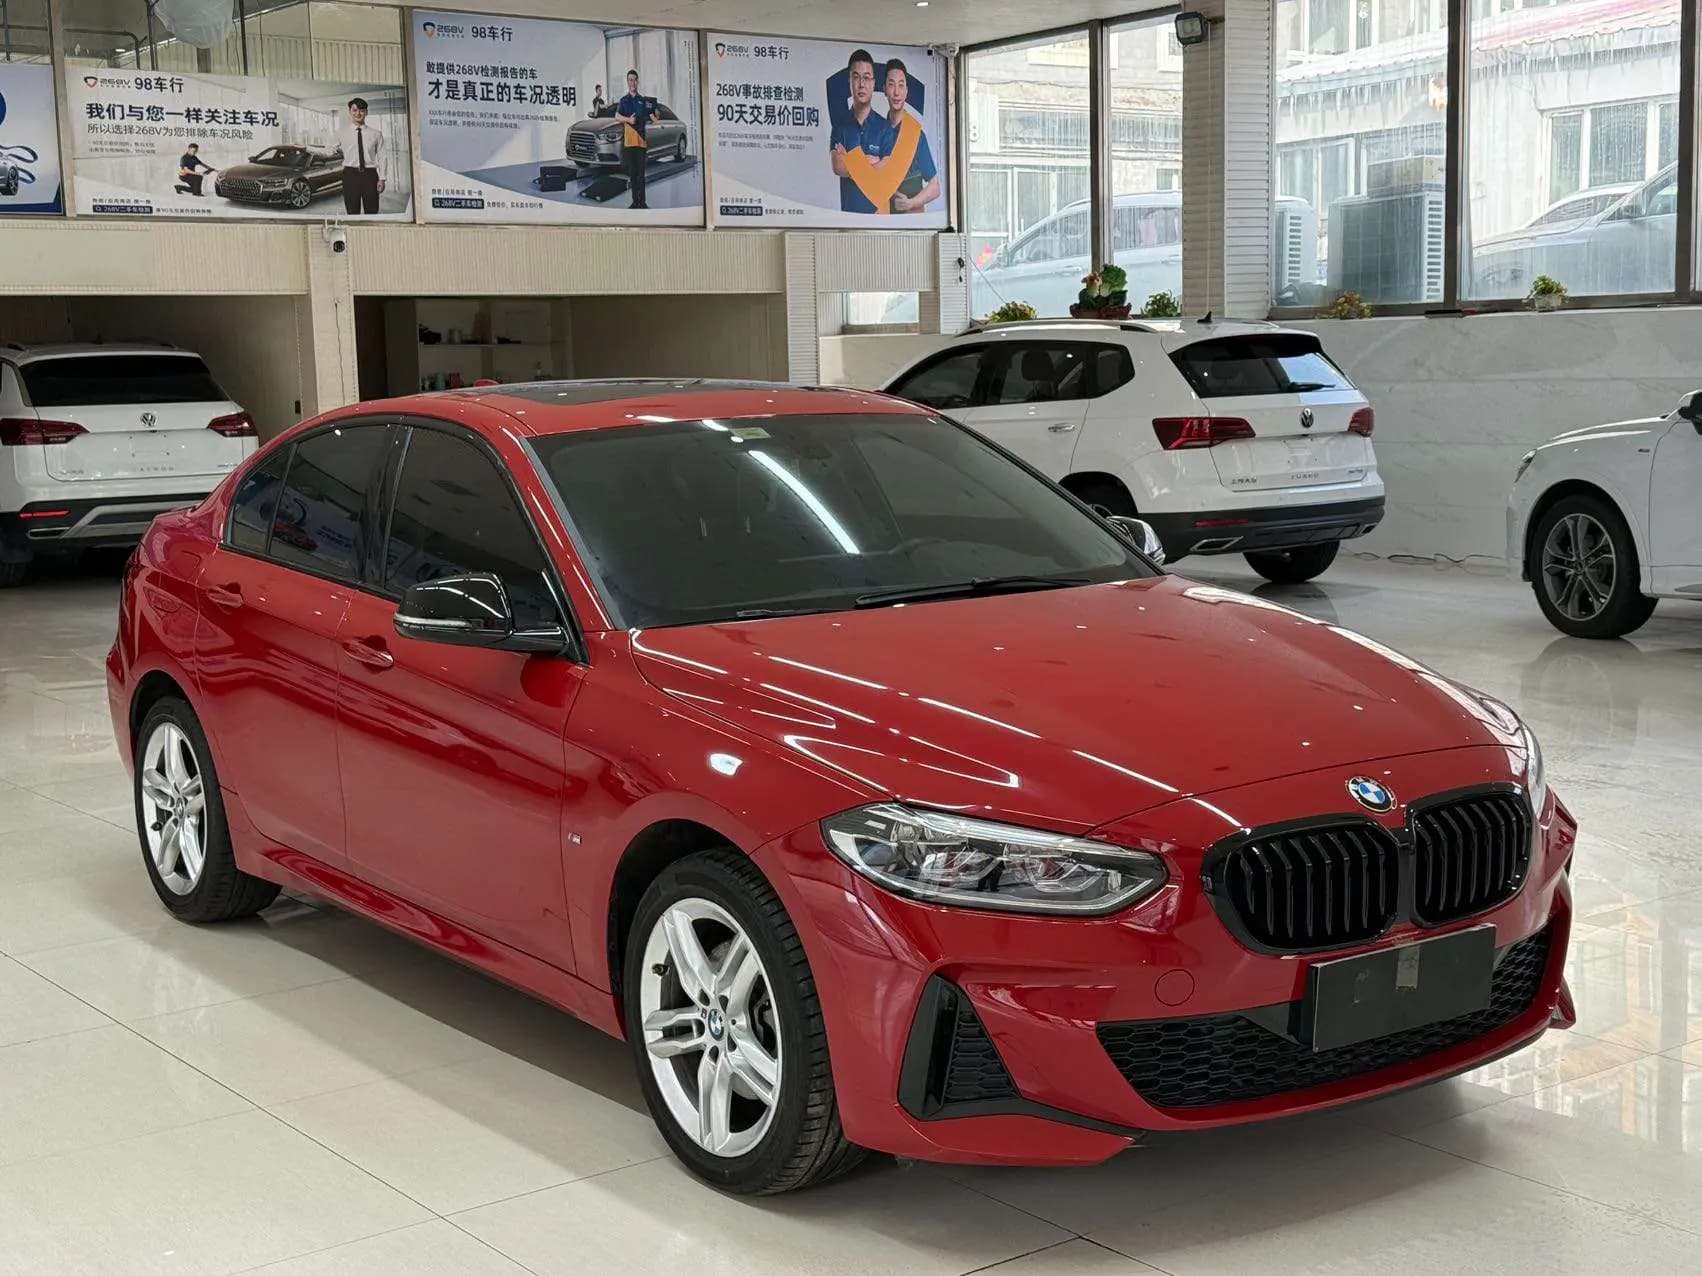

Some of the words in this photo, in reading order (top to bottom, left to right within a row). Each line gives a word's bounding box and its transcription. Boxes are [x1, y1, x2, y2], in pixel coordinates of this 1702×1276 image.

[471, 26, 513, 42] 98车行
[754, 46, 789, 60] 98车行
[426, 61, 538, 80] 敢提供268V检测报告的车
[135, 77, 184, 93] 98车行
[428, 78, 576, 106] 才是真正的车况透明
[716, 83, 804, 102] 268V事故排查检测
[86, 103, 280, 127] 我们与您一样关注车况
[717, 104, 820, 127] 90天交易价回购
[87, 123, 254, 140] 所以选择268V为您排除车况风险
